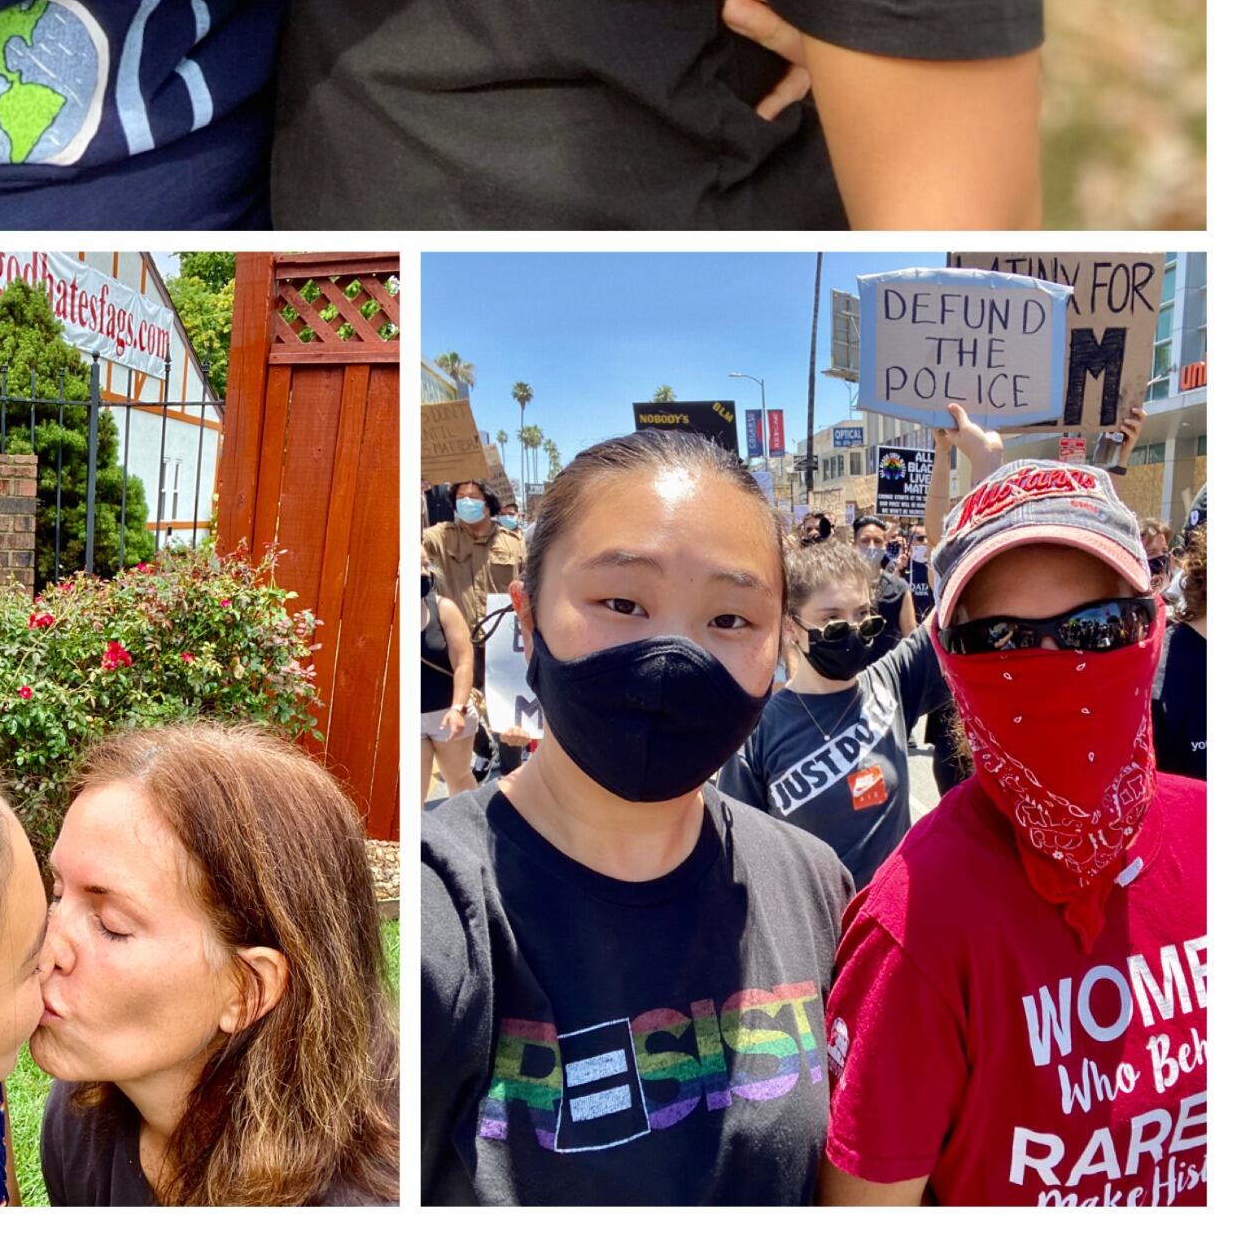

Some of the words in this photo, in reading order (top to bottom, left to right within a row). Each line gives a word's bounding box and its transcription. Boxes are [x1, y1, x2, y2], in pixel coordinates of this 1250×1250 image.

[1091, 262, 1155, 316] FOR
[883, 288, 1046, 335] DEFUND
[925, 337, 1006, 369] THE
[885, 365, 1030, 409] POLICE
[638, 413, 691, 424] NOBODY'S
[712, 401, 734, 423] BLM
[834, 429, 862, 440] OPTICAL
[915, 452, 933, 463] ALL
[1190, 741, 1207, 752] yo
[775, 747, 842, 811] JUST
[835, 718, 875, 764] DO
[1058, 1058, 1141, 1115] Who
